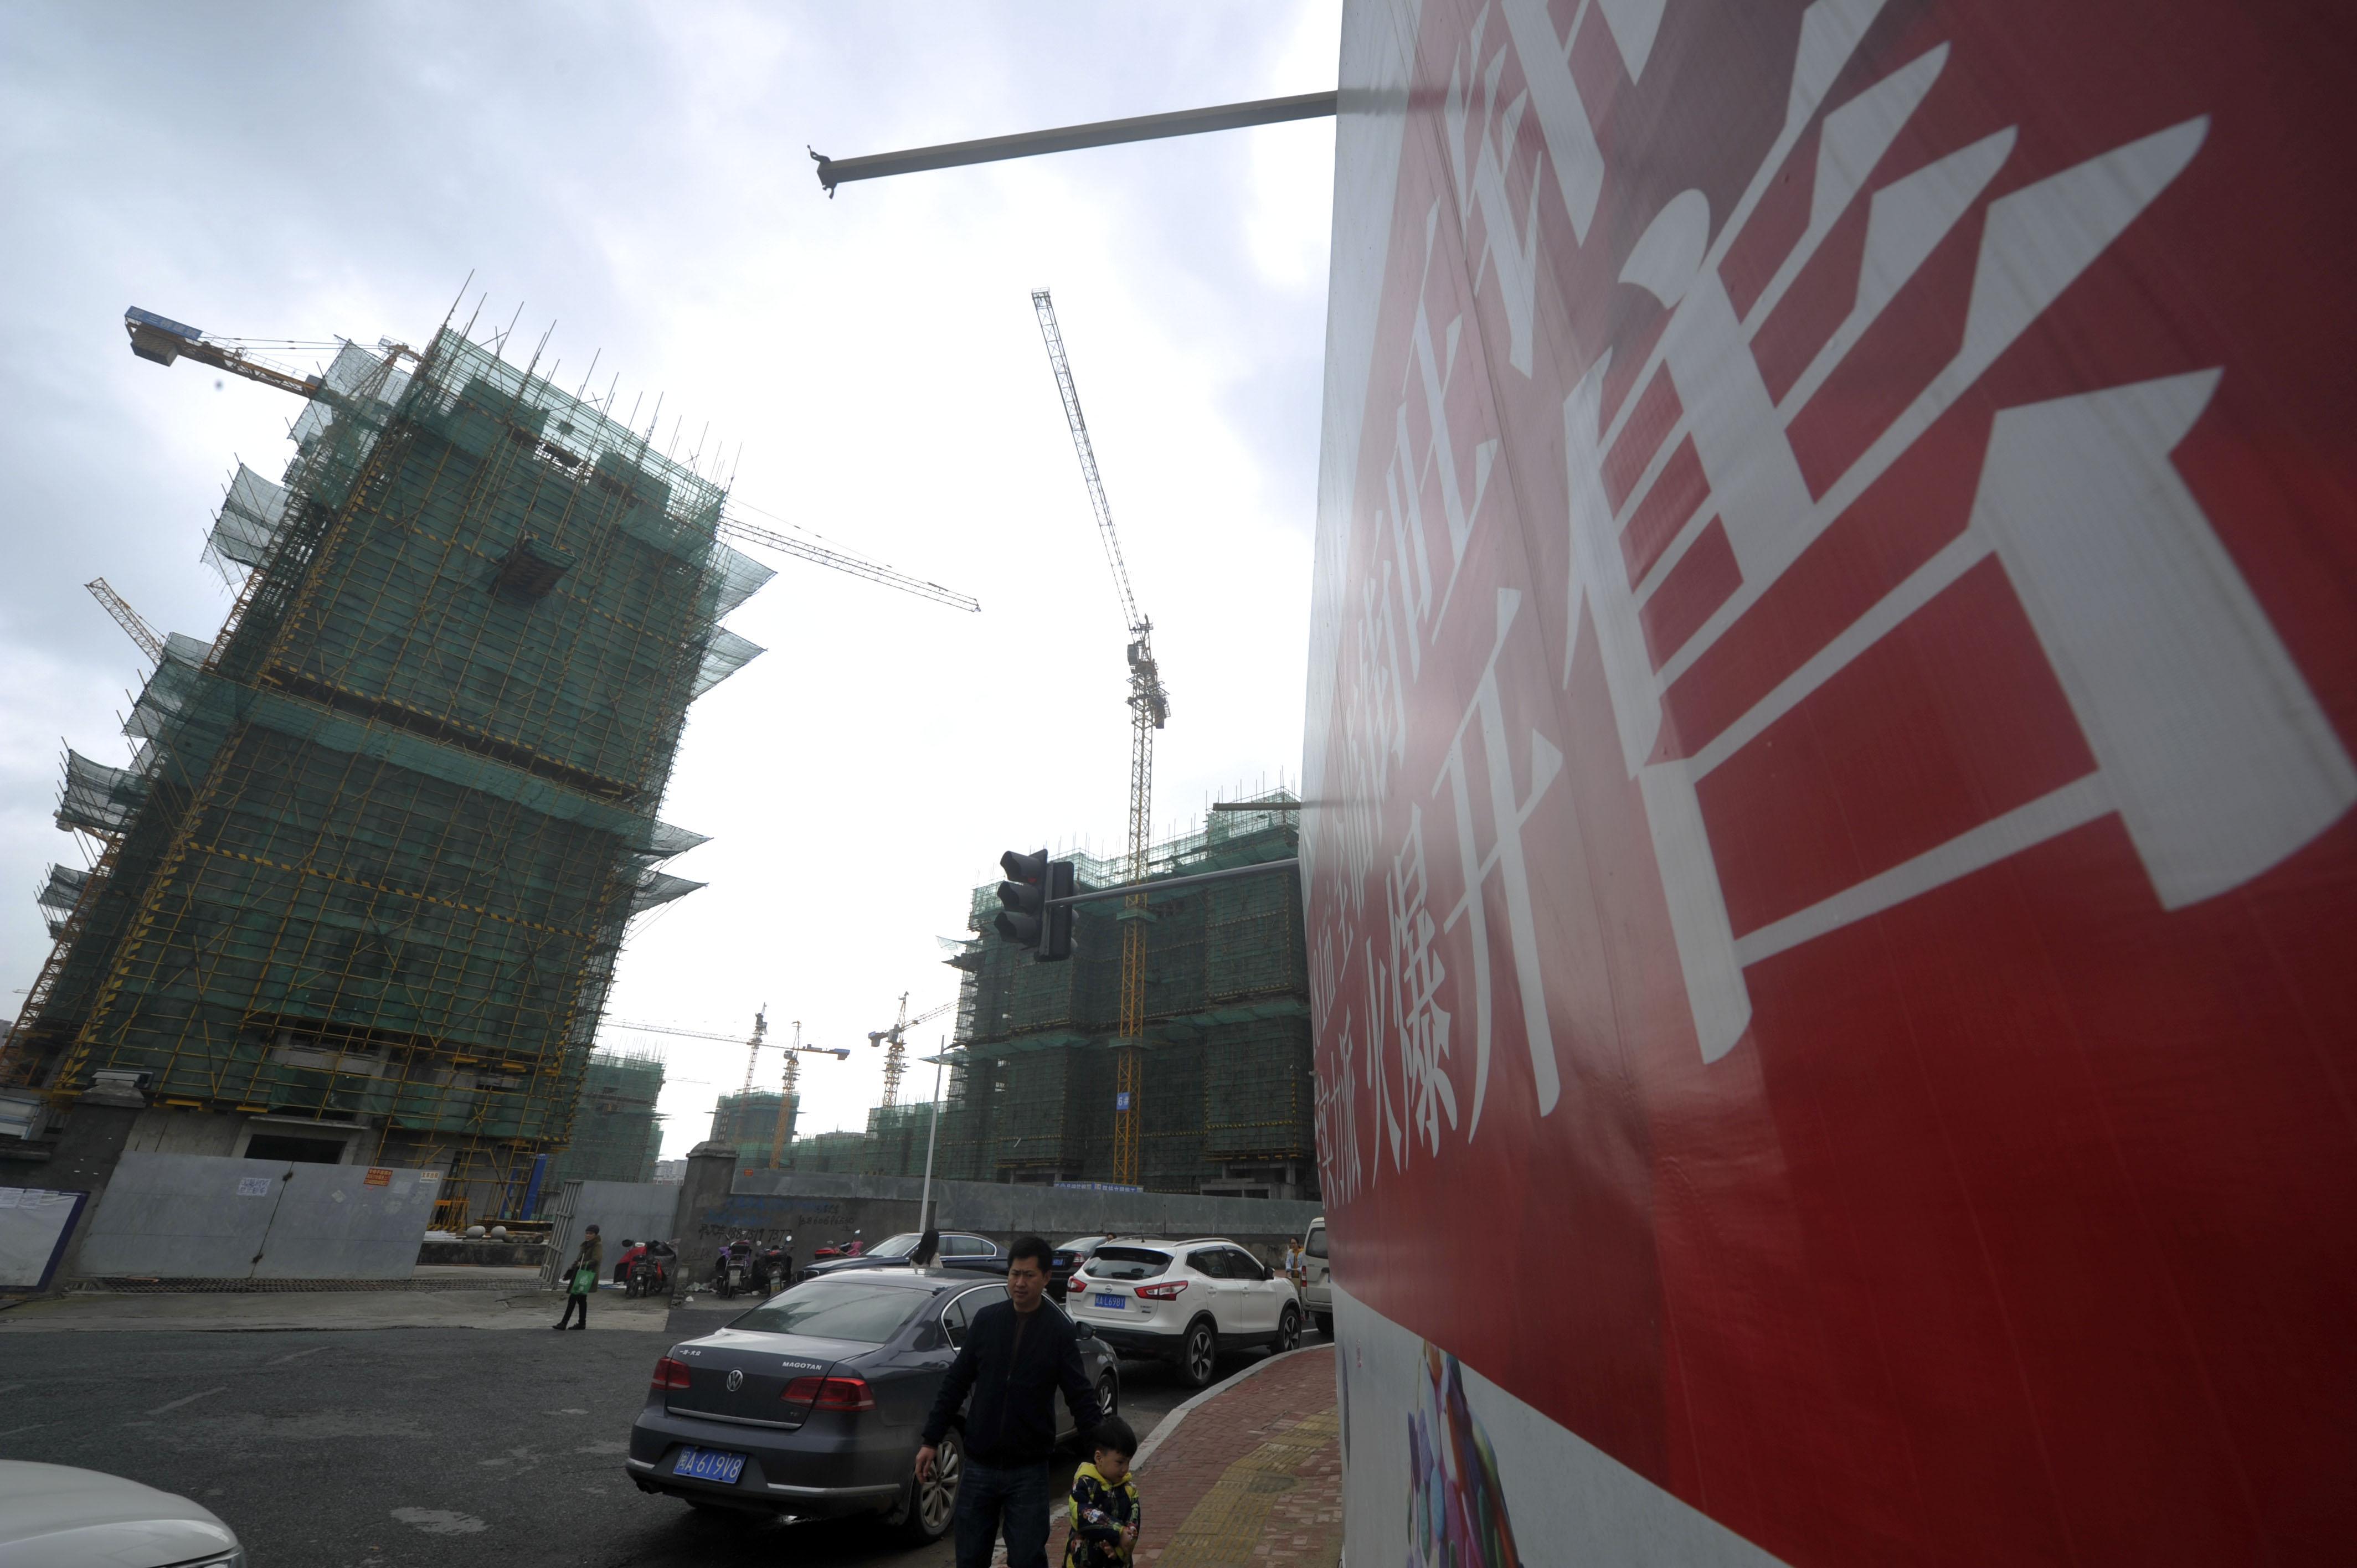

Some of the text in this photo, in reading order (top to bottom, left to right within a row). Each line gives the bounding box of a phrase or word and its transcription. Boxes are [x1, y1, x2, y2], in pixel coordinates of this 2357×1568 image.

[1315, 0, 2357, 1214] 实力派 火爆开售
[1118, 1096, 1129, 1106] 6#
[782, 1361, 822, 1370] MAGOTAN
